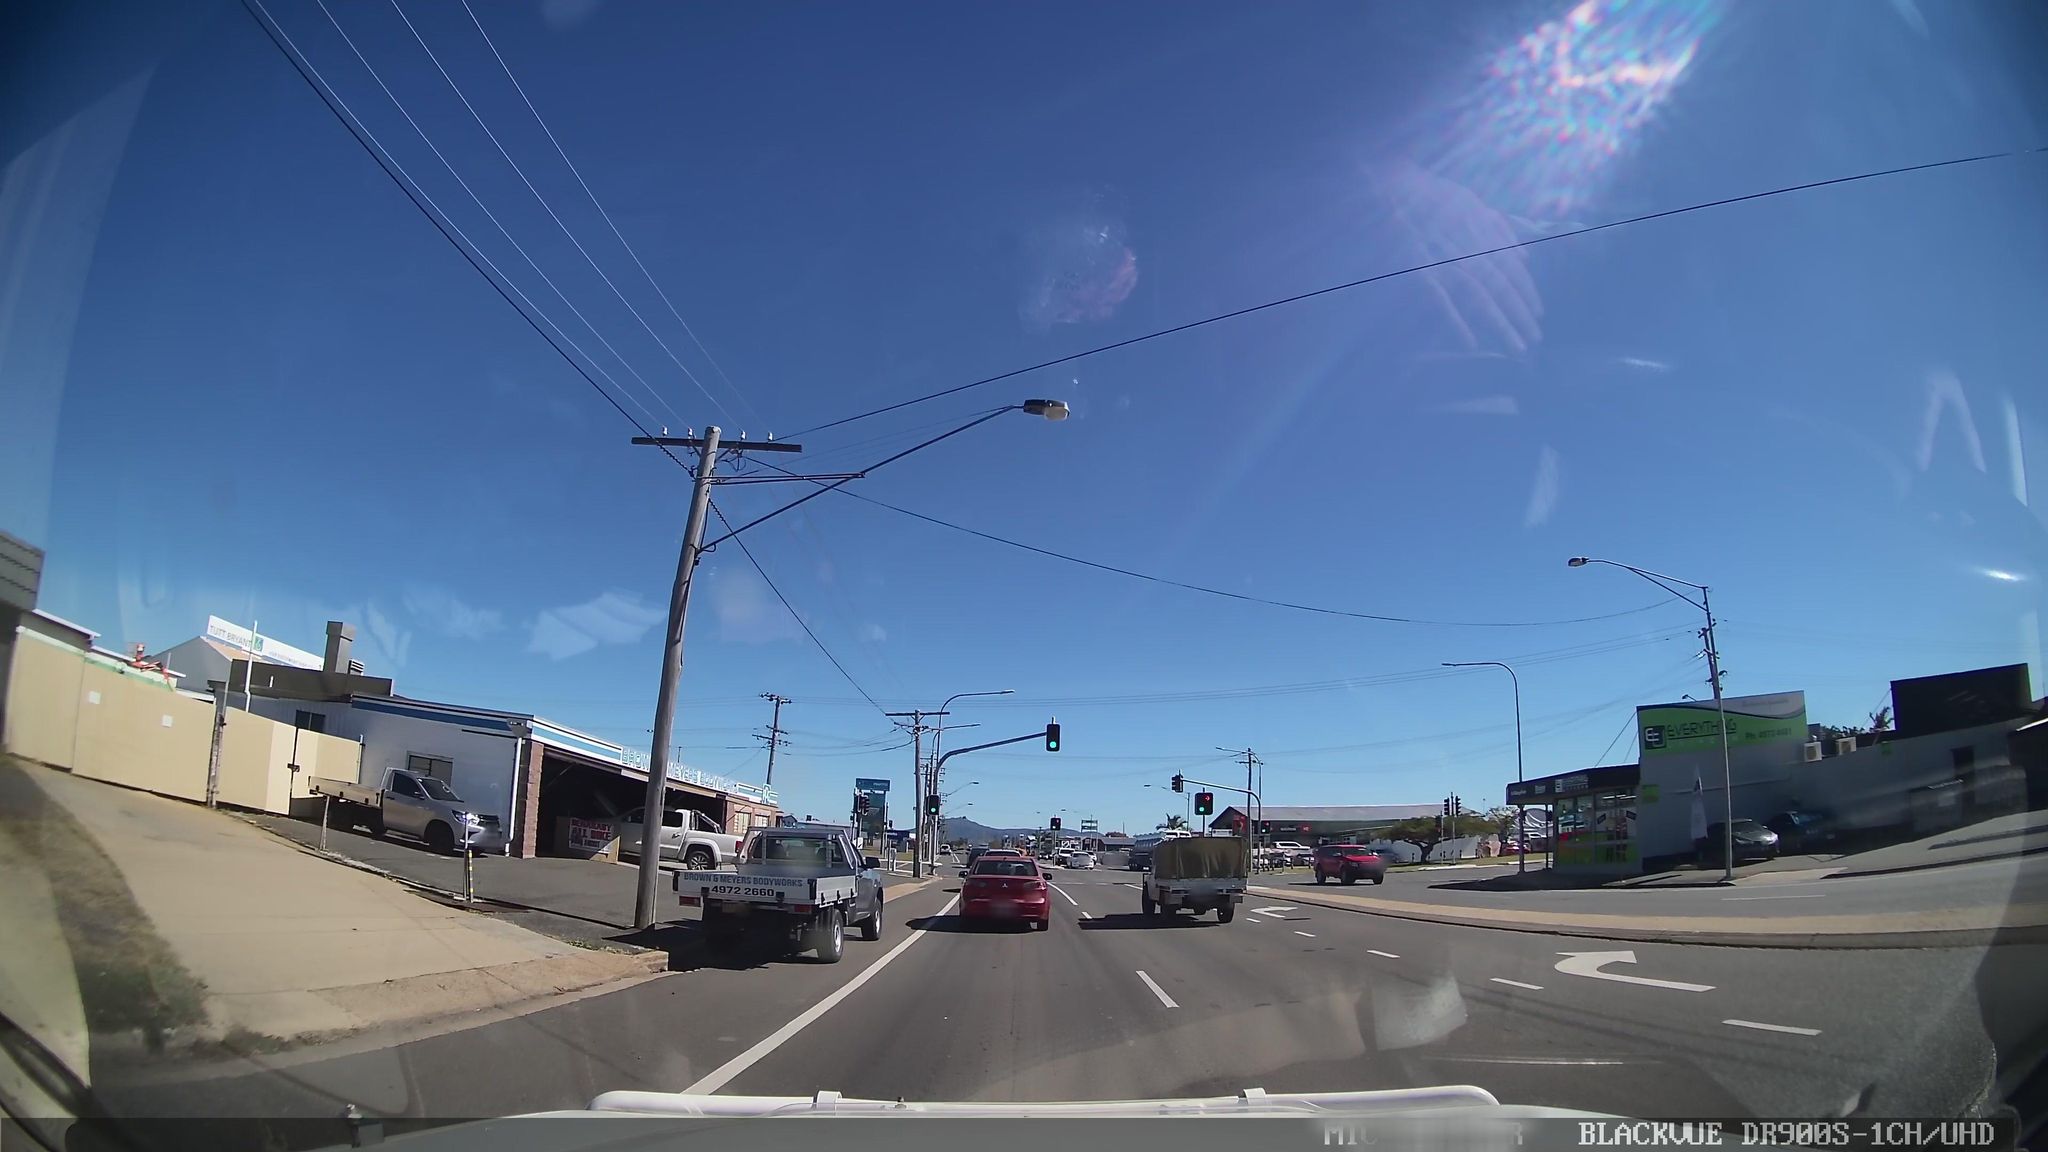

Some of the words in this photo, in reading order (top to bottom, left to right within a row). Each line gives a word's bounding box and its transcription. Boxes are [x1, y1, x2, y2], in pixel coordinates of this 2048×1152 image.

[210, 625, 225, 638] TUTT
[684, 872, 713, 883] BROWN
[720, 875, 752, 886] MEYERS
[753, 876, 803, 888] BODYWORKS
[711, 884, 743, 895] 4972
[744, 887, 775, 898] 2660
